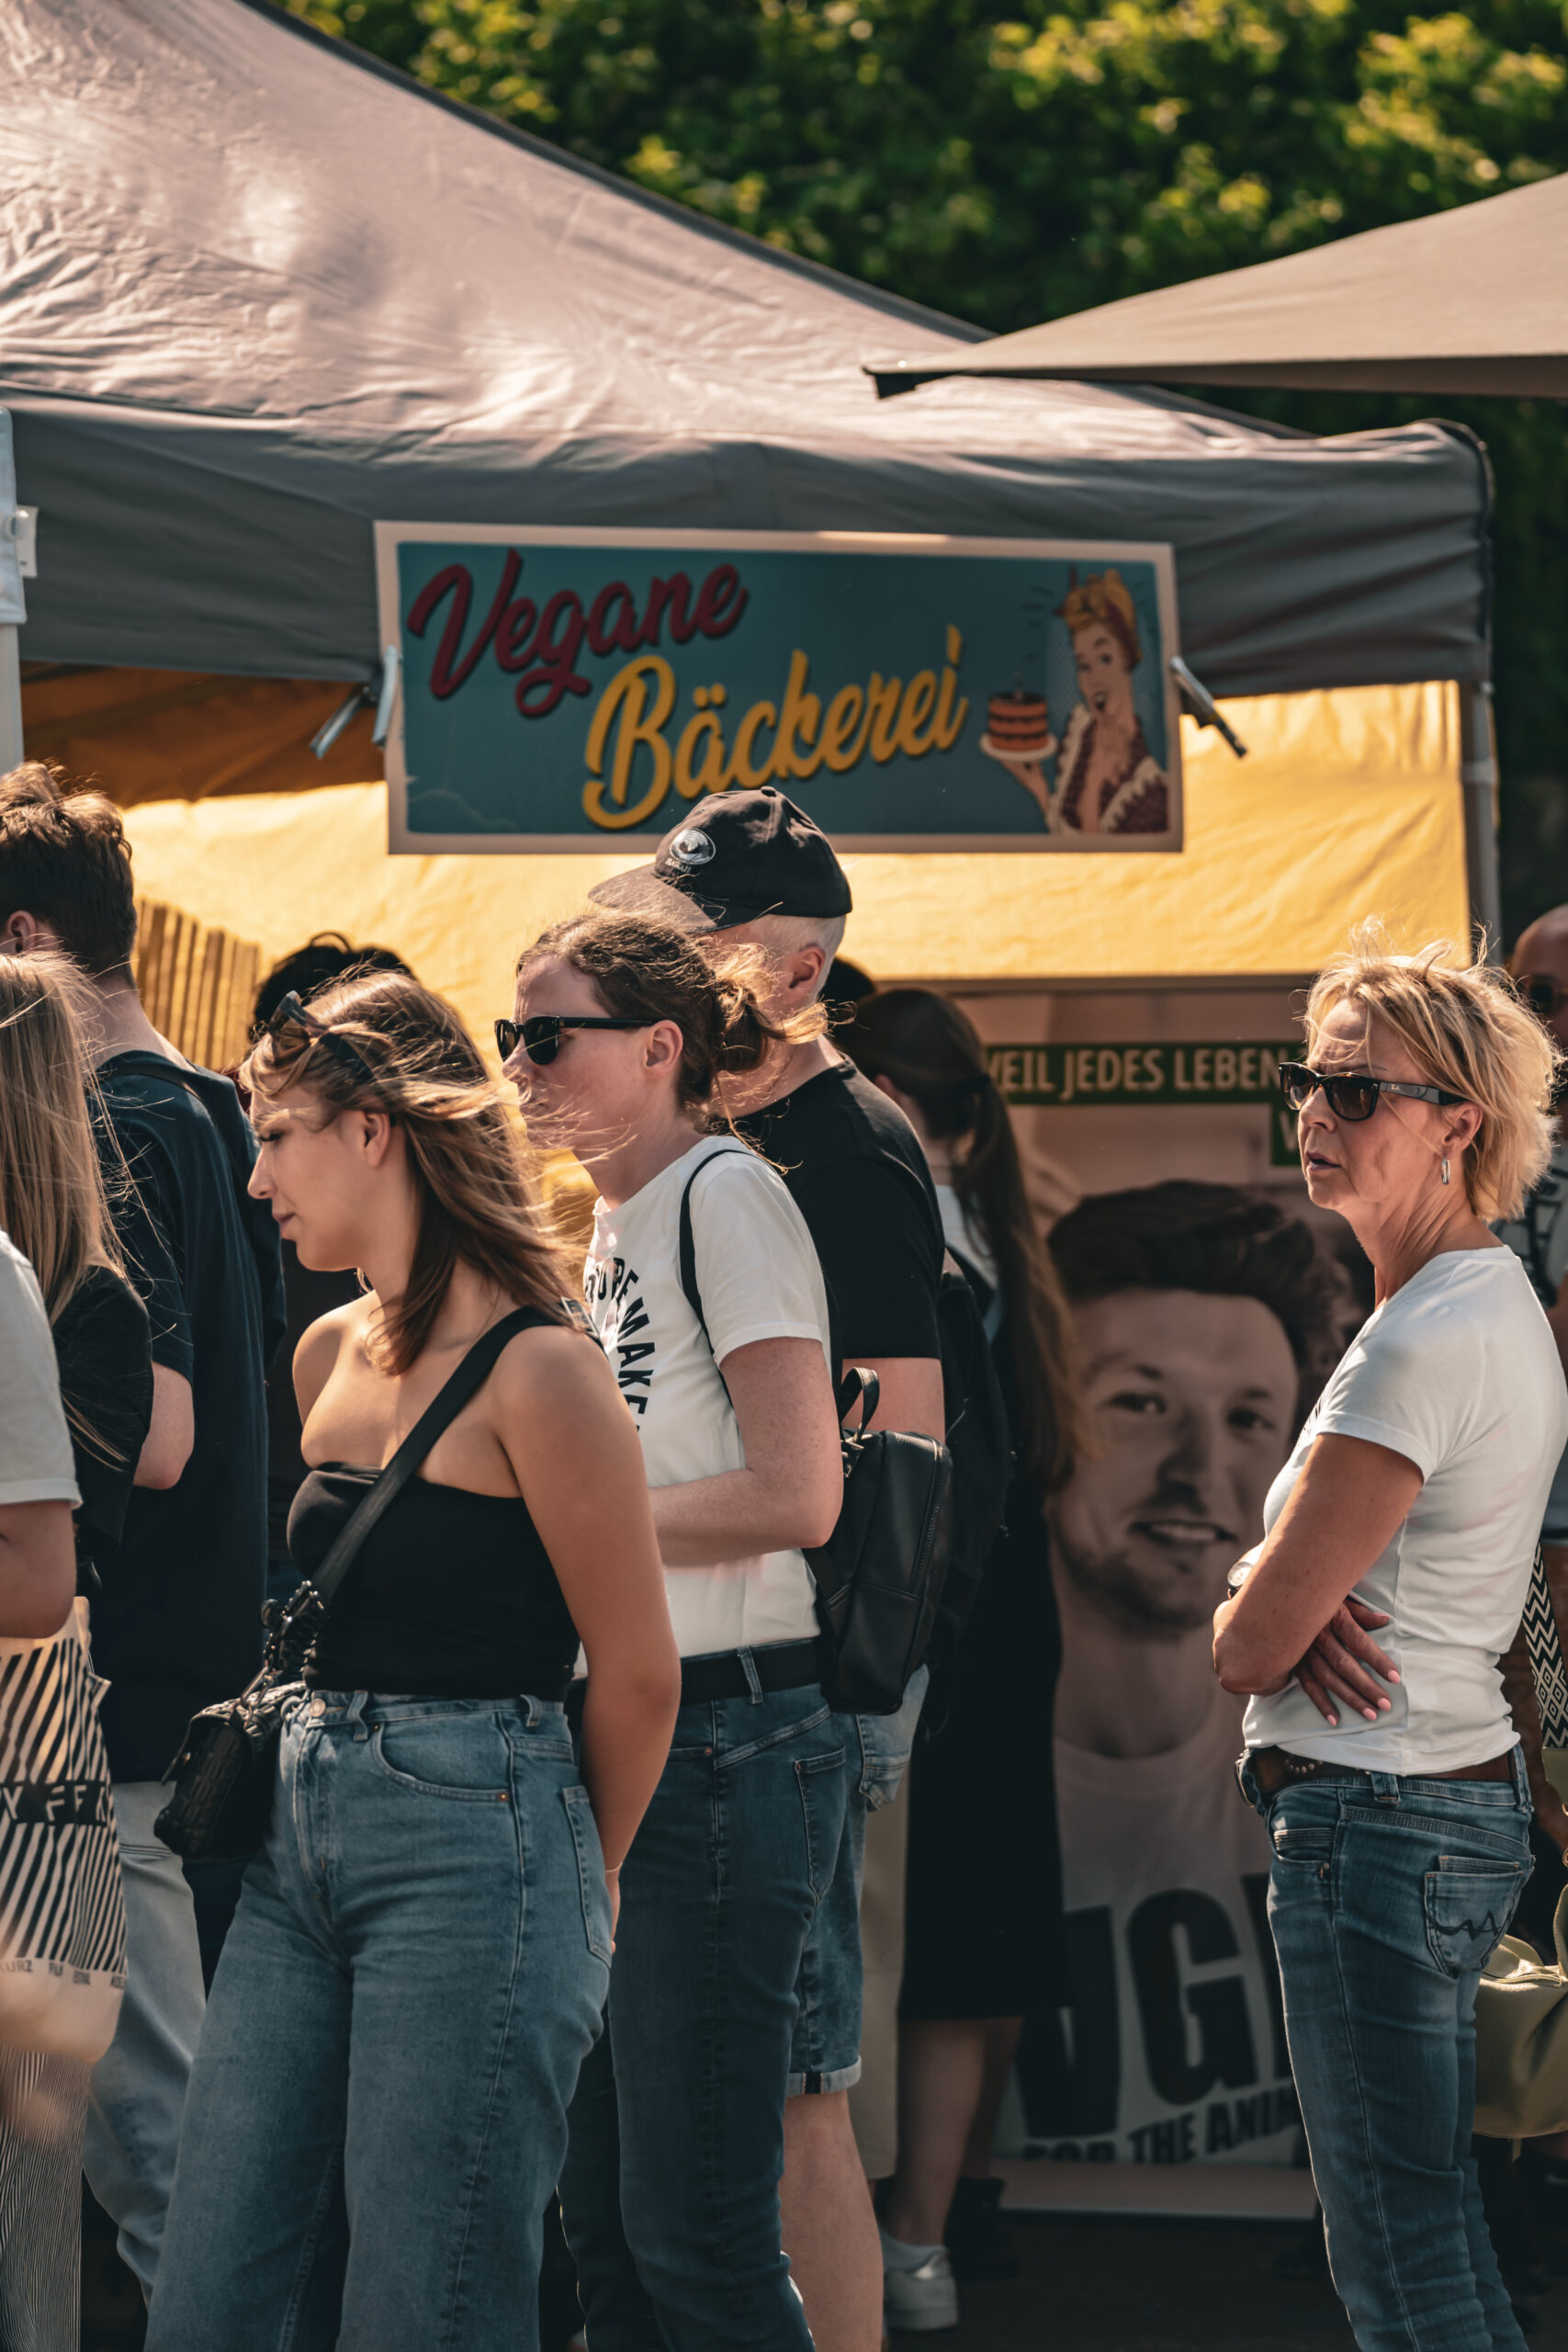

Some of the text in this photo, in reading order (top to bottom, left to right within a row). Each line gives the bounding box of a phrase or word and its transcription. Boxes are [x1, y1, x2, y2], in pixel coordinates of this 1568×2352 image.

[406, 548, 748, 718] Vegane
[581, 623, 968, 831] Bäckerei
[1059, 1049, 1165, 1101] JEDES
[1173, 1048, 1287, 1091] LEBEN
[1127, 2113, 1197, 2163] THE
